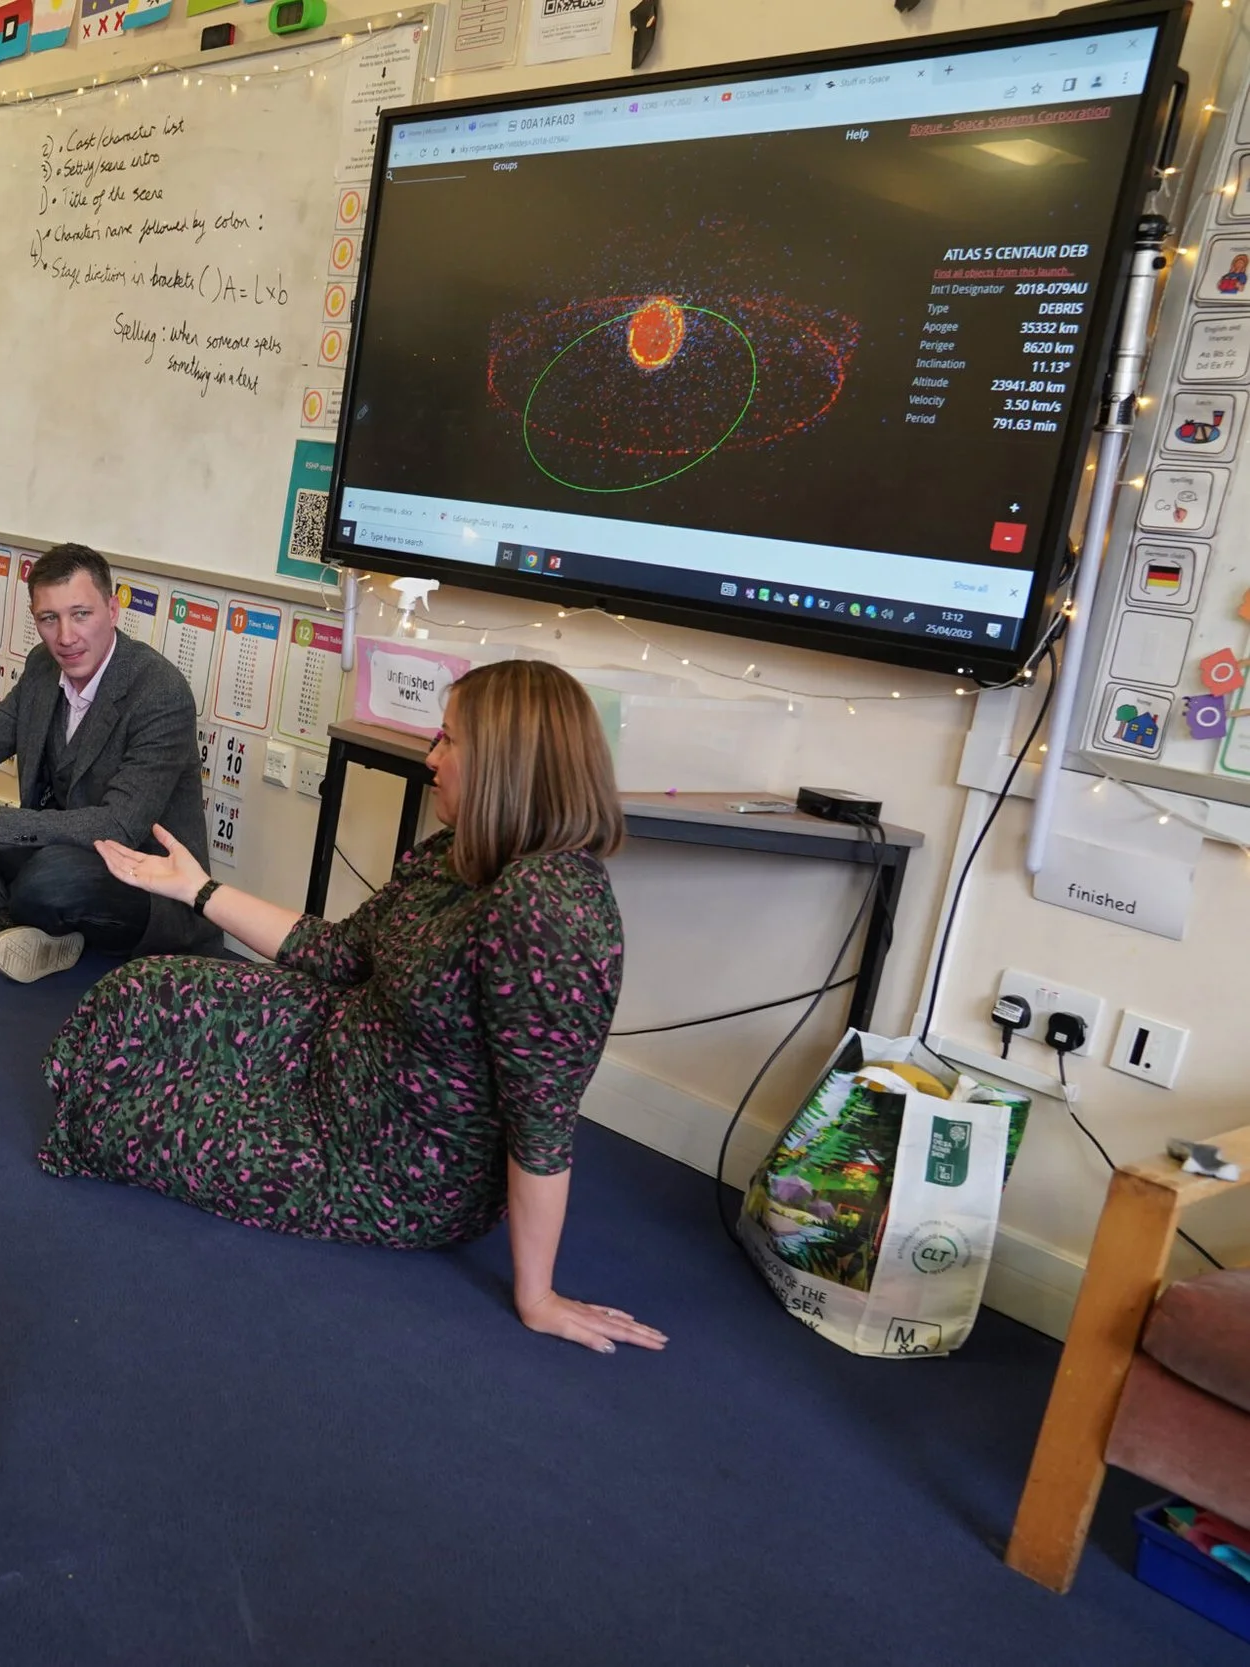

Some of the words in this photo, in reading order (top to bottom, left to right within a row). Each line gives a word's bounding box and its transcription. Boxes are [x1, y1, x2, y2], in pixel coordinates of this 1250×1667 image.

[868, 74, 891, 86] Space
[163, 115, 185, 135] list
[520, 114, 575, 131] 00A1AFA03
[910, 123, 943, 136] Rogue
[953, 118, 985, 132] Space
[988, 113, 1034, 129] Systems
[1037, 105, 1111, 122] Corporation
[845, 128, 870, 142] Help
[131, 150, 160, 168] intro
[493, 161, 518, 172] Groups
[62, 187, 88, 208] Title
[93, 186, 106, 215] of
[108, 185, 126, 202] the
[133, 187, 163, 201] scene
[105, 223, 133, 240] name
[139, 217, 189, 244] followed
[192, 209, 206, 244] by
[214, 211, 251, 229] colon
[943, 248, 981, 261] ATLAS
[984, 248, 993, 259] 5
[995, 246, 1057, 260] CENTAUR
[1059, 244, 1089, 258] DEB
[131, 260, 145, 284] in
[150, 262, 195, 291] brackets
[934, 269, 951, 279] Find
[954, 269, 963, 278] all
[965, 268, 995, 280] objects
[997, 267, 1017, 278] from
[1019, 267, 1036, 277] this
[951, 284, 1005, 297] Designator
[1014, 283, 1088, 295] 2018-079AU
[927, 303, 950, 316] Type
[1038, 302, 1084, 315] DEBRIS
[169, 320, 199, 346] when
[206, 335, 250, 351] someone
[922, 322, 959, 334] Apogee
[1020, 322, 1058, 334] 35332
[1059, 322, 1079, 334] km
[919, 340, 955, 353] Perigee
[1023, 341, 1053, 354] 8620
[1054, 342, 1074, 354] km
[915, 358, 966, 369] Inclination
[1031, 361, 1071, 373] 11.13°
[167, 354, 211, 398] something
[214, 362, 227, 385] in
[236, 366, 259, 395] text
[912, 376, 949, 388] Altitude
[990, 380, 1044, 392] 23941.80
[1045, 381, 1066, 393] km
[909, 395, 945, 408] Velocity
[1003, 399, 1029, 411] 3.50
[1030, 399, 1062, 413] km/s
[905, 413, 936, 424] Period
[992, 417, 1031, 431] 791.63
[1033, 419, 1057, 432] min
[370, 532, 383, 542] Type
[384, 534, 396, 543] here
[397, 536, 404, 544] to
[404, 538, 423, 548] search
[24, 565, 31, 578] 7
[953, 580, 975, 591] Show
[977, 584, 988, 593] all
[132, 596, 143, 604] Times
[143, 599, 154, 608] Table
[175, 604, 186, 619] 10
[189, 610, 201, 620] Times
[201, 613, 213, 623] Table
[942, 612, 964, 623] 13:12
[234, 614, 244, 628] 11
[248, 620, 261, 629] Times
[261, 622, 275, 632] Table
[925, 624, 973, 639] 25/04/2023
[298, 627, 310, 641] 12
[314, 632, 329, 643] Times
[387, 670, 435, 692] Unfinished
[201, 746, 208, 762] 9
[226, 754, 242, 774] 10
[222, 775, 240, 788] zehn
[215, 802, 239, 820] vingt
[217, 819, 233, 840] 20
[212, 839, 234, 857] zwanzig
[1068, 883, 1136, 914] finished
[921, 1248, 952, 1263] CLT
[786, 1277, 798, 1290] OF
[800, 1285, 828, 1304] THE
[893, 1326, 916, 1343] M
